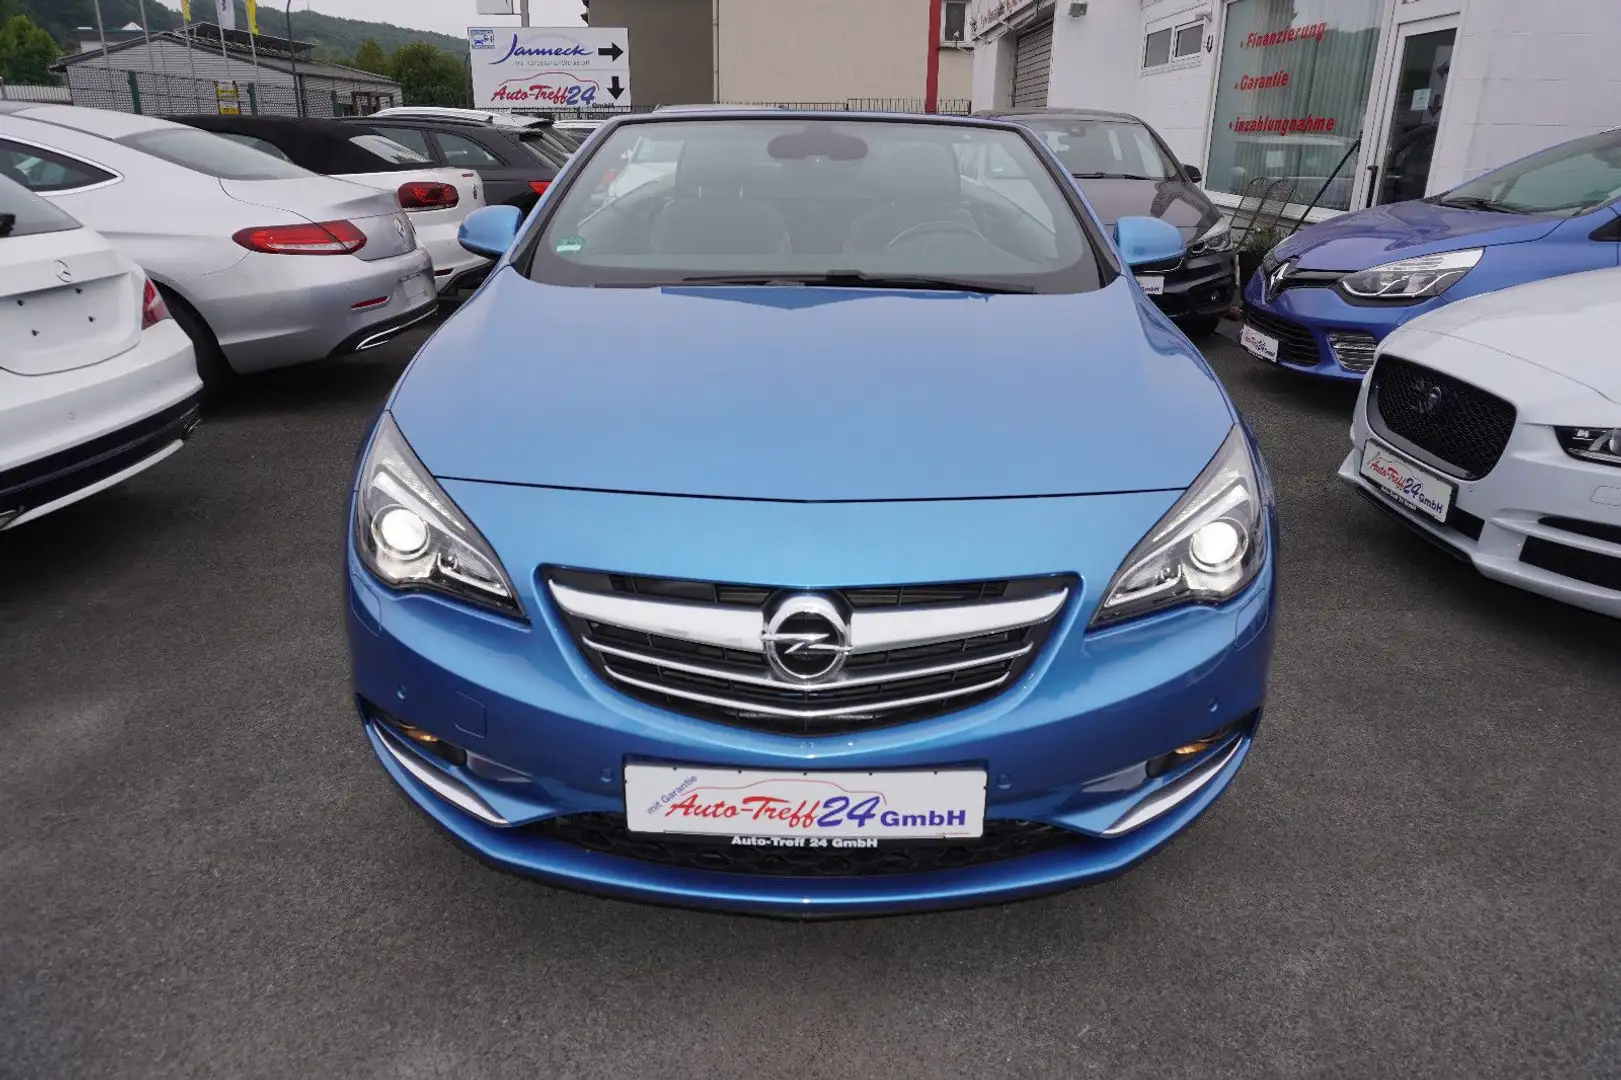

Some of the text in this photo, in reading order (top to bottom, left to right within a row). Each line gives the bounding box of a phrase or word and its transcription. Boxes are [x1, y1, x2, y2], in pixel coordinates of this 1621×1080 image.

[1245, 22, 1327, 49] Finanzierung
[1240, 68, 1289, 91] Garantie
[1418, 493, 1443, 514] GmbH
[647, 775, 698, 815] mit Garantie
[880, 810, 966, 828] GmbH
[731, 835, 878, 849] Auto-Treff 24 GmbH
